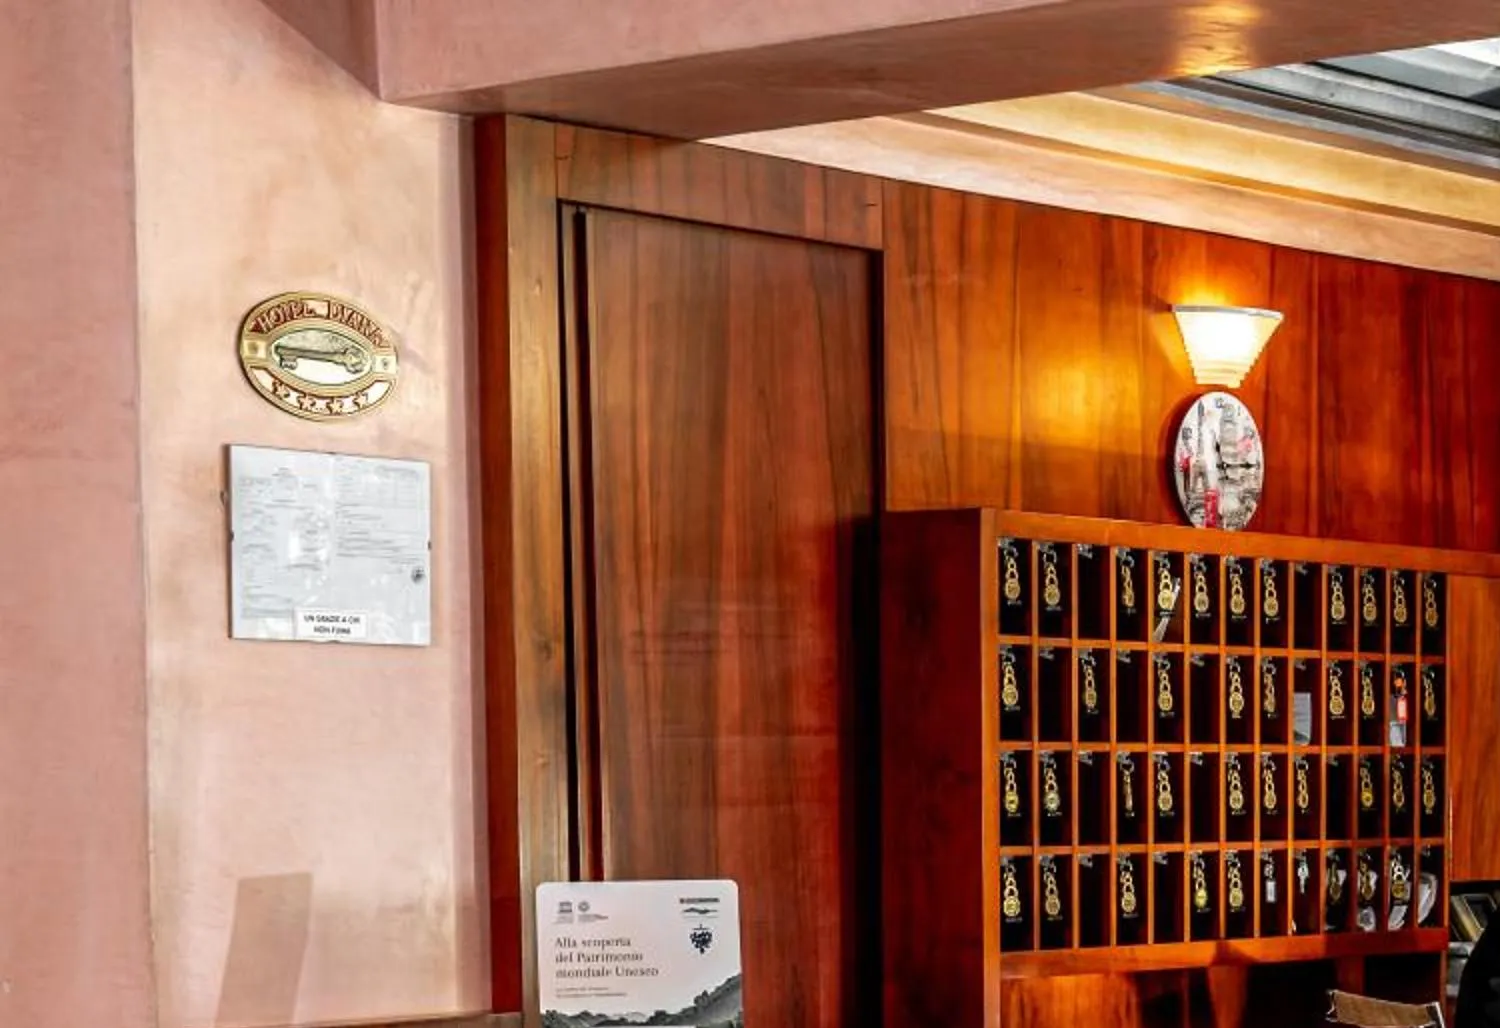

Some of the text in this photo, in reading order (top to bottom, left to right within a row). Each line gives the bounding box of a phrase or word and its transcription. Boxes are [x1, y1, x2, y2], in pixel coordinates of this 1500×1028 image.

[256, 301, 315, 332] HOTEL
[556, 937, 631, 950] Alla scoperta
[555, 952, 643, 963] del Patrimonio
[555, 965, 659, 978] mondiale Unesco
